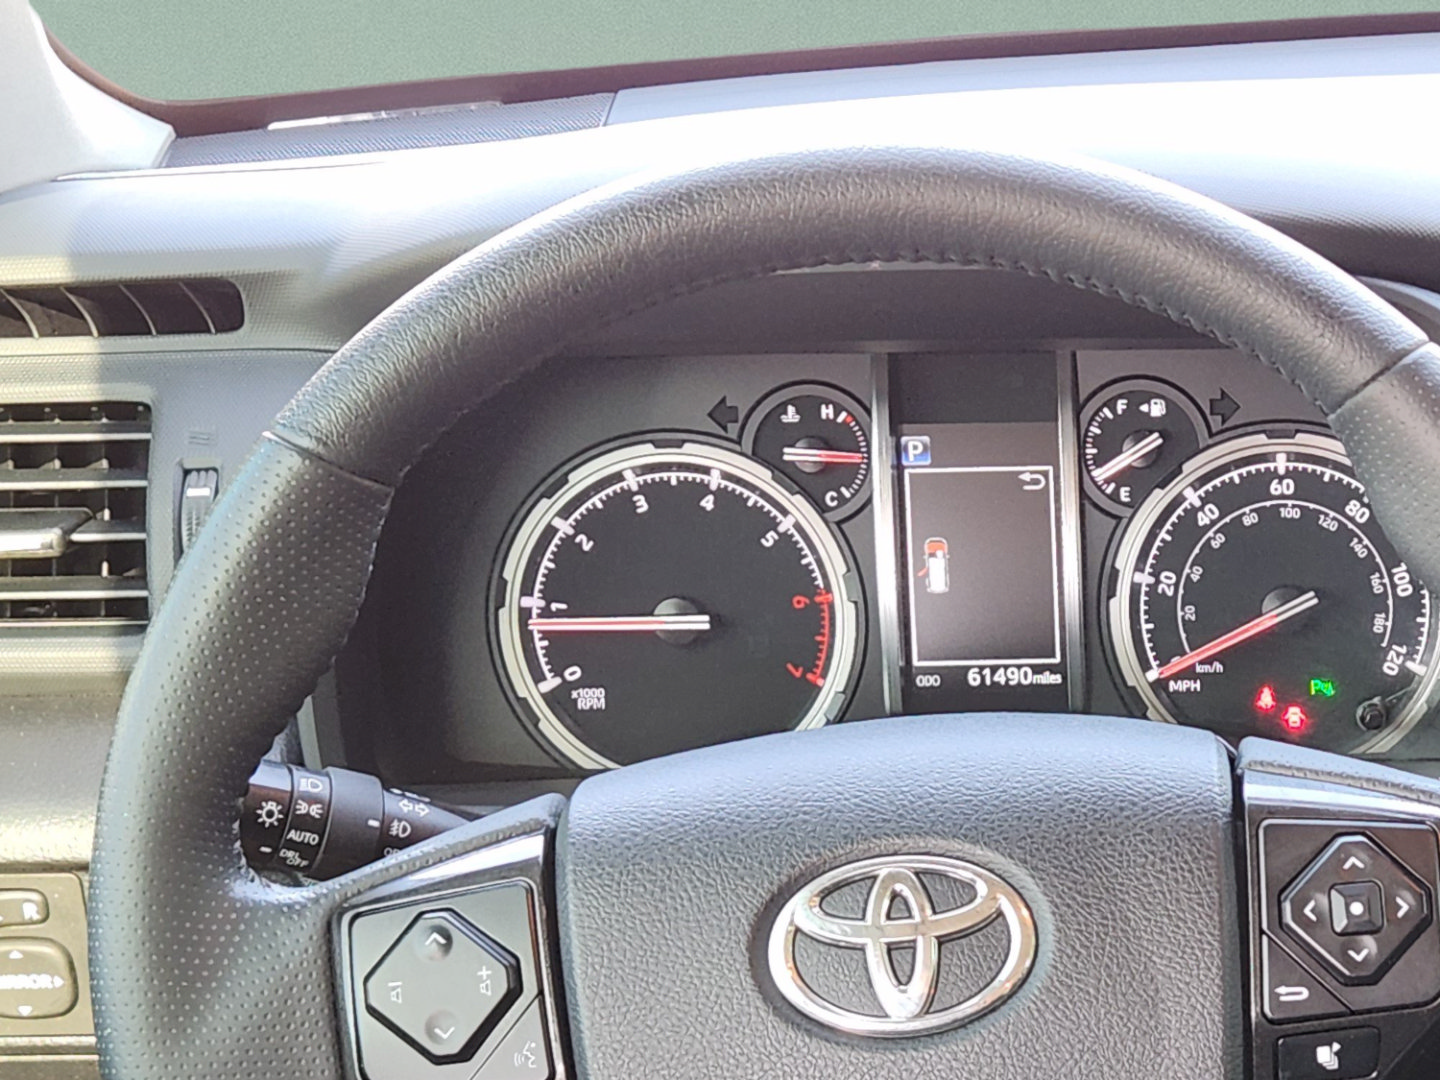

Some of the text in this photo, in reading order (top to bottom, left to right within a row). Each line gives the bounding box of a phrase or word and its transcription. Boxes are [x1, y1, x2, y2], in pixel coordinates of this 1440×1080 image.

[821, 404, 833, 419] H
[1117, 400, 1128, 414] F
[907, 441, 924, 462] P
[1120, 487, 1131, 502] E
[1269, 478, 1295, 496] 60
[634, 495, 649, 513] 3
[700, 495, 715, 512] 4
[825, 492, 838, 507] C
[1196, 503, 1221, 528] 40
[1242, 511, 1259, 527] 80
[1280, 506, 1301, 519] 100
[1344, 500, 1370, 525] 80
[1318, 514, 1339, 532] 120
[574, 534, 595, 551] 2
[760, 531, 779, 548] 5
[1210, 533, 1226, 550] 60
[1349, 537, 1369, 559] 140
[1190, 566, 1204, 583] 40
[1391, 562, 1414, 598] 100
[1158, 571, 1177, 597] 20
[1370, 572, 1384, 595] 160
[550, 602, 568, 612] 1
[792, 595, 810, 609] 6
[1184, 605, 1196, 622] 20
[1372, 611, 1386, 634] 180
[1196, 660, 1224, 673] km/h
[1383, 643, 1408, 677] 120
[564, 665, 582, 682] 0
[786, 662, 804, 680] 7
[916, 667, 1062, 687] ODO 61490 miles
[1168, 679, 1201, 692] MPH
[577, 698, 606, 710] RPM
[286, 828, 320, 846] AUTO
[22, 901, 41, 921] R
